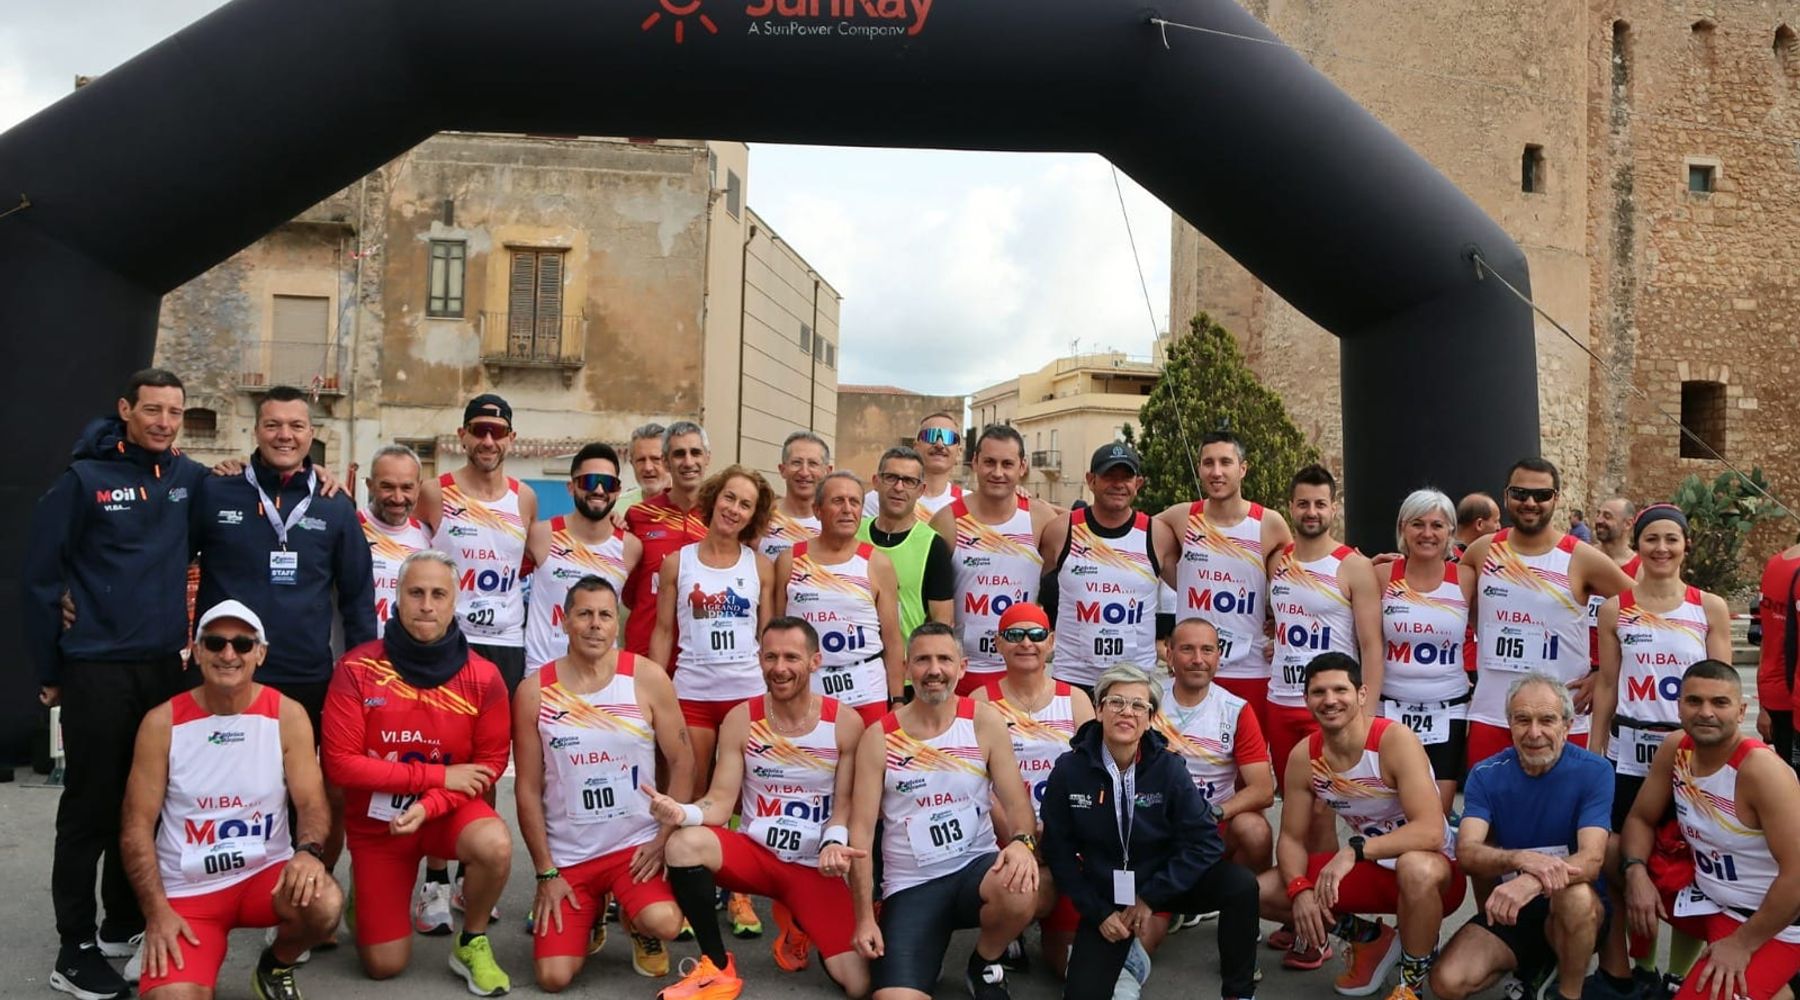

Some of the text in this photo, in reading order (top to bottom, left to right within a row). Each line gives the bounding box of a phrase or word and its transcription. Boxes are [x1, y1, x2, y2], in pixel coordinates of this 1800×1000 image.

[748, 22, 759, 34] A
[763, 21, 832, 35] SunPower
[271, 569, 295, 577] STAFF
[708, 603, 741, 612] GRAND
[715, 595, 736, 604] XXI
[711, 630, 735, 650] 011
[822, 624, 865, 653] Oil
[979, 637, 997, 653] 03
[1094, 637, 1124, 656] 030
[1218, 638, 1233, 658] 31
[1496, 637, 1524, 658] 015
[821, 672, 854, 695] 006
[1283, 665, 1306, 684] 012
[1628, 675, 1682, 701] MO
[1402, 714, 1433, 733] 024
[1636, 743, 1658, 763] 00
[583, 787, 615, 810] 010
[766, 826, 802, 851] 026
[929, 818, 964, 848] 013
[204, 851, 245, 875] 005
